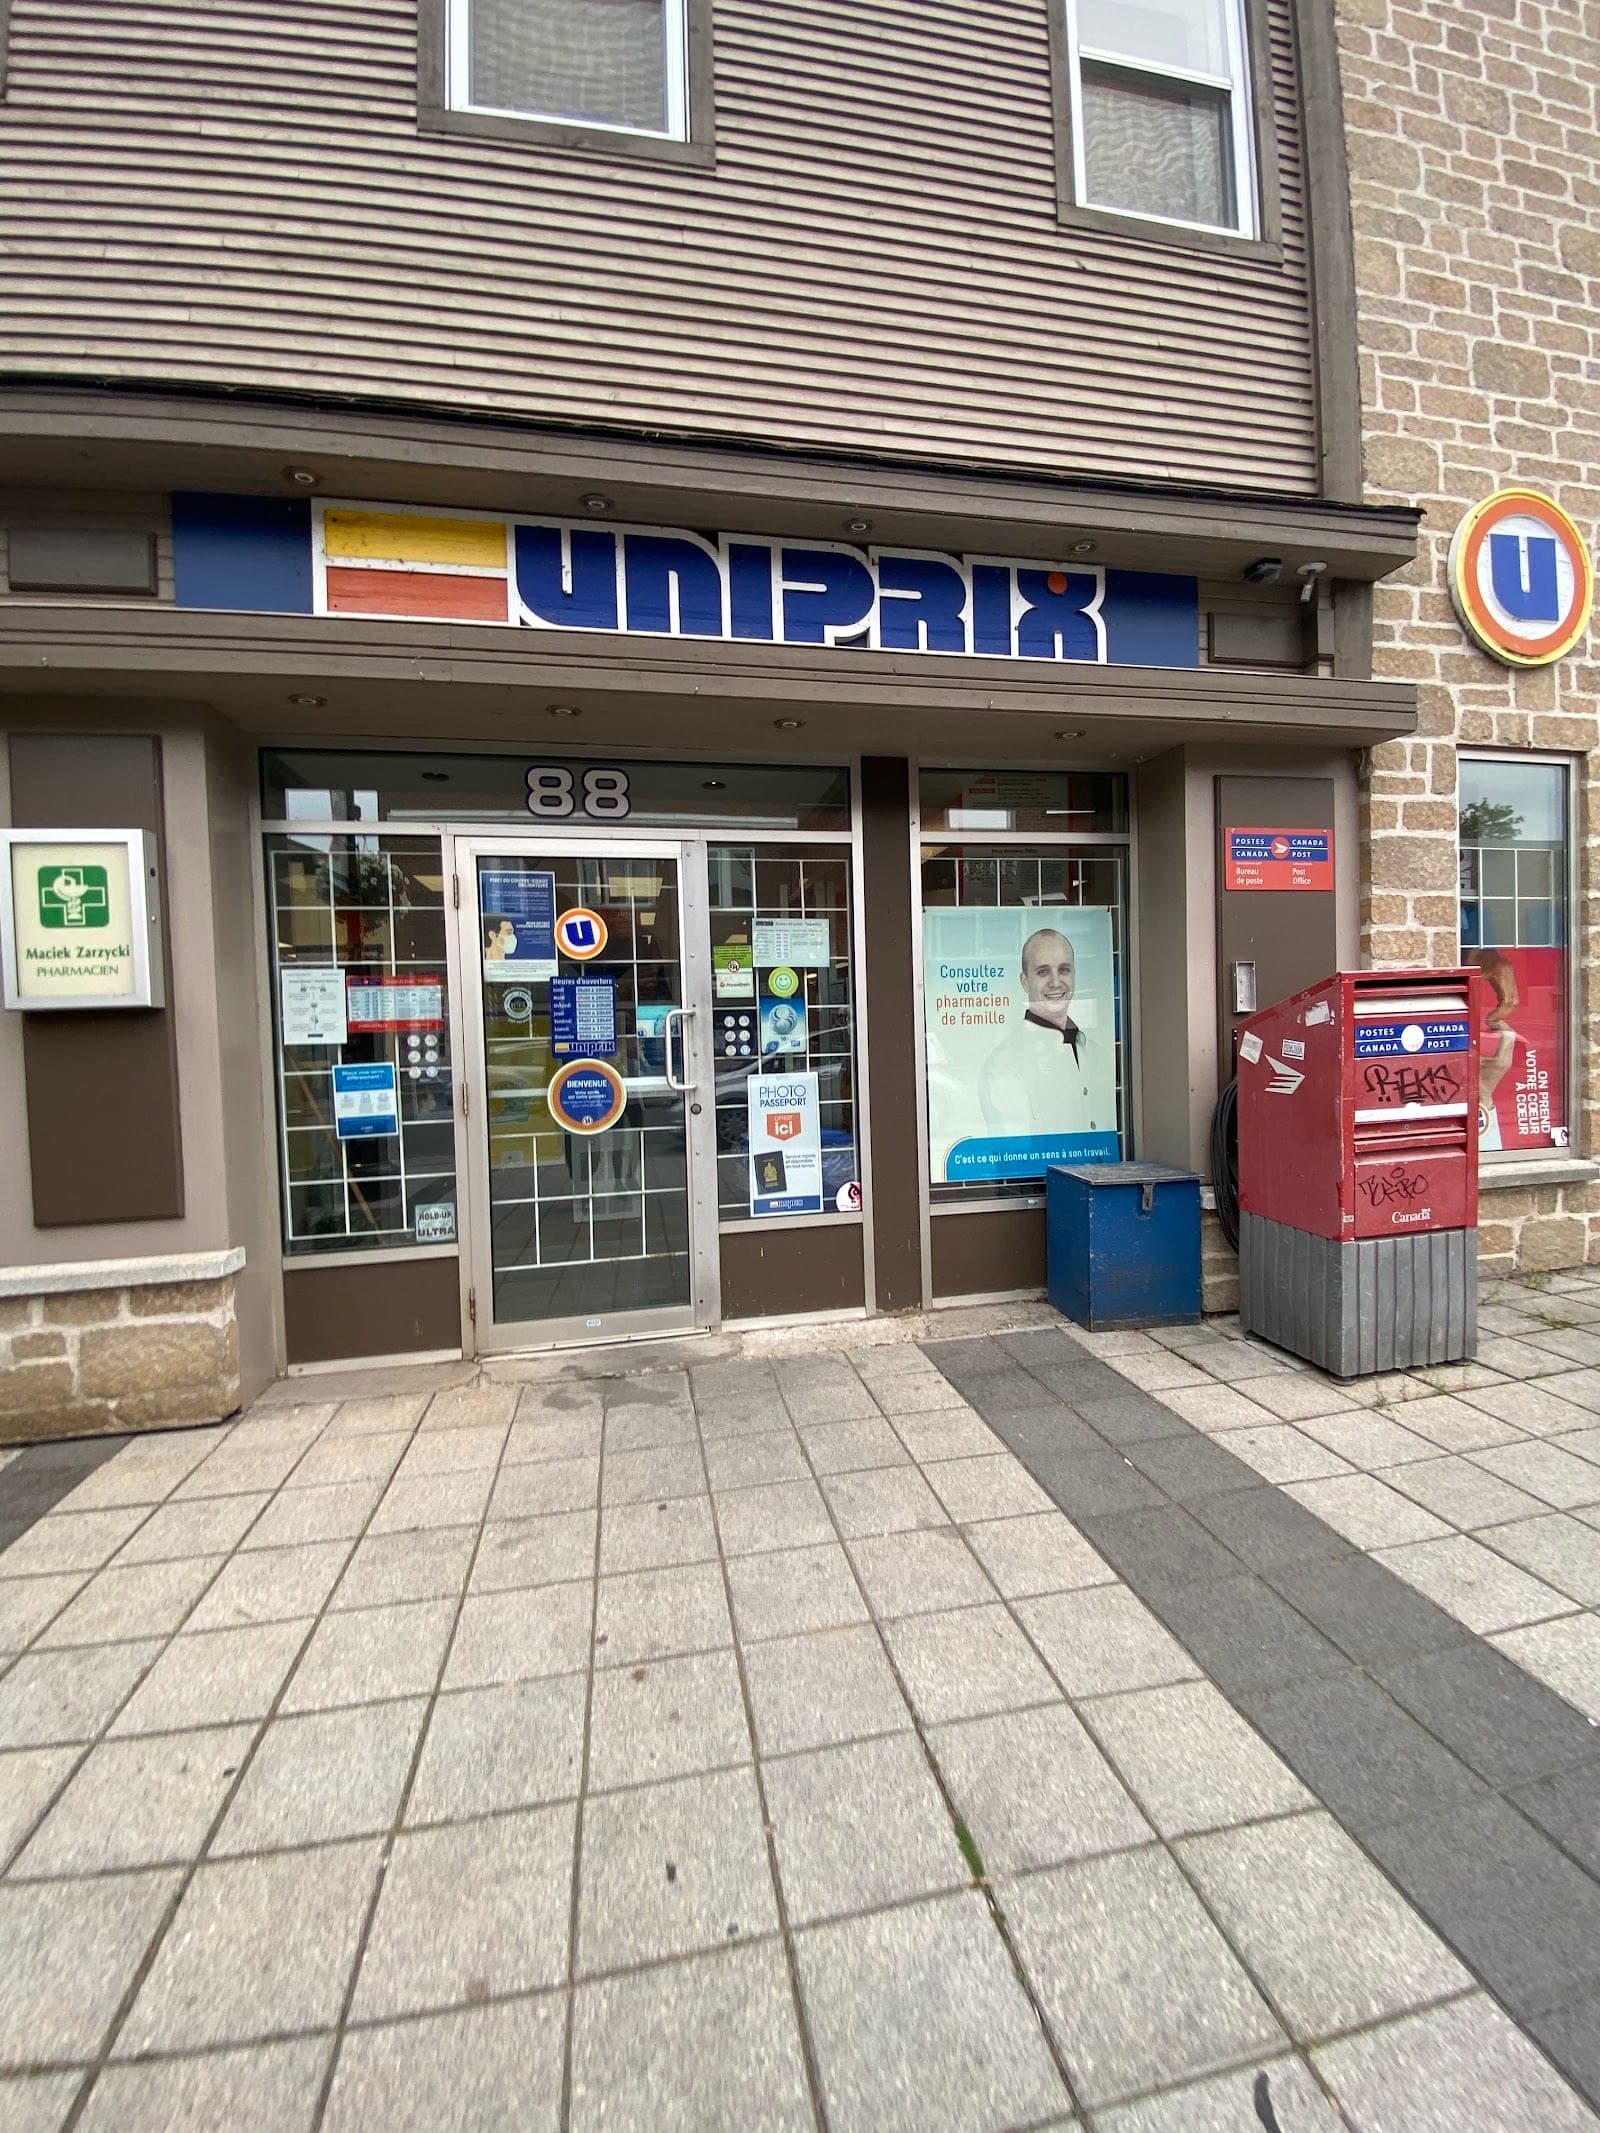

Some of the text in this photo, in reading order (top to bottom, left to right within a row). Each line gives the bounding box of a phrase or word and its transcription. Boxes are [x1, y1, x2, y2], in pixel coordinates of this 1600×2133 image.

[524, 764, 631, 819] 88
[1236, 867, 1260, 875] Bureau
[1292, 868, 1307, 876] Post
[1236, 877, 1264, 887] de poste
[1292, 877, 1312, 885] Office
[26, 944, 130, 961] Maciek Zarzycki
[36, 965, 119, 977] PHARMACIEN
[940, 964, 1005, 978] Consultez
[956, 979, 988, 993] votre
[936, 993, 1010, 1012] pharmacien
[941, 1010, 1006, 1025] de famille
[1359, 1027, 1395, 1037] POSTES
[1426, 1024, 1464, 1033] CANADA
[1359, 1043, 1399, 1053] CANADA
[1427, 1040, 1450, 1049] POST
[1526, 1049, 1538, 1091] VOTRE
[566, 1079, 608, 1089] BIENVENUE
[759, 1084, 807, 1099] PHOTO
[759, 1097, 807, 1108] PASSEPORT
[1537, 1070, 1551, 1134] ON PREND
[774, 1120, 794, 1136] ici
[954, 1146, 1111, 1165] C'est ce qui donne un sens à son travail.
[1391, 1209, 1431, 1224] Canada
[417, 1227, 454, 1237] ULTRA
